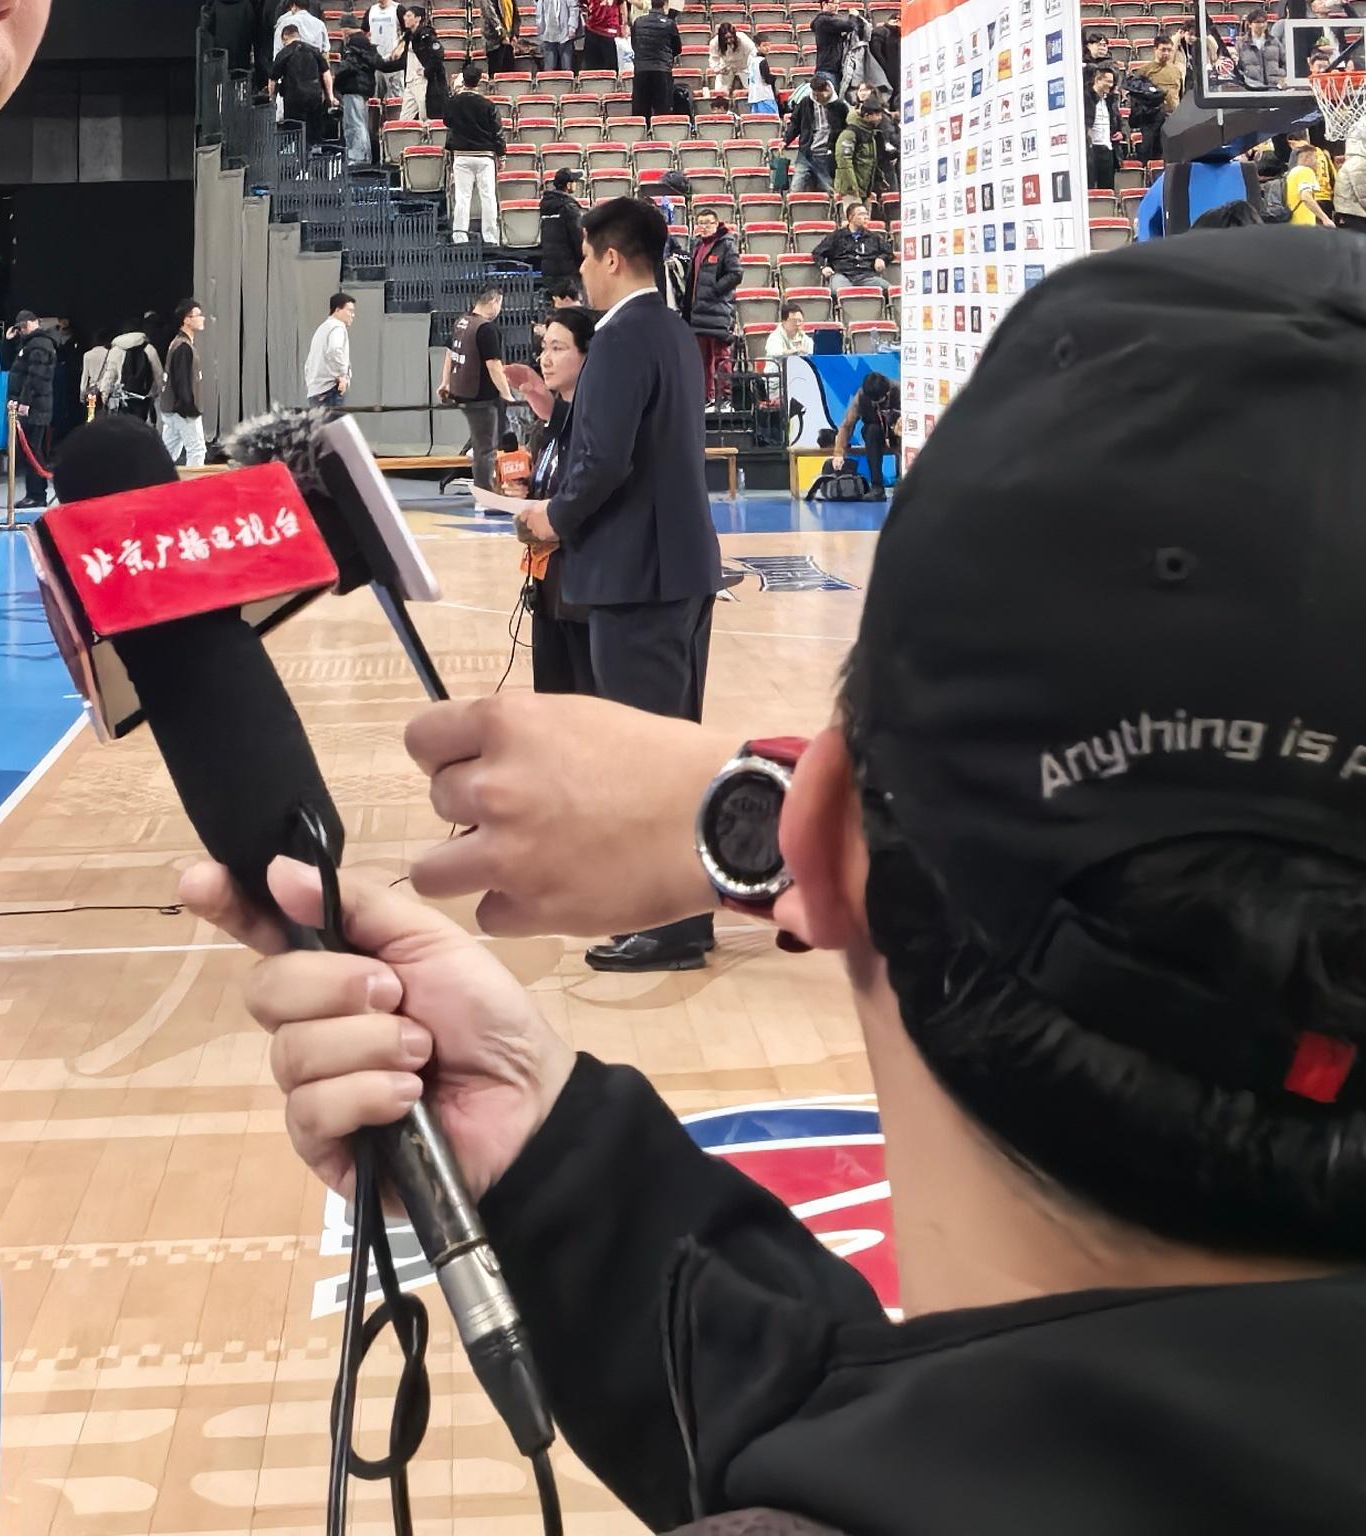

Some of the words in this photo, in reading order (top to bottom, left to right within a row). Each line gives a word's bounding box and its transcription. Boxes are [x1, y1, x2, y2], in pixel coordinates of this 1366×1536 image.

[79, 507, 301, 584] 北京广播电视台
[1039, 710, 1266, 799] Anything
[1280, 717, 1337, 763] is
